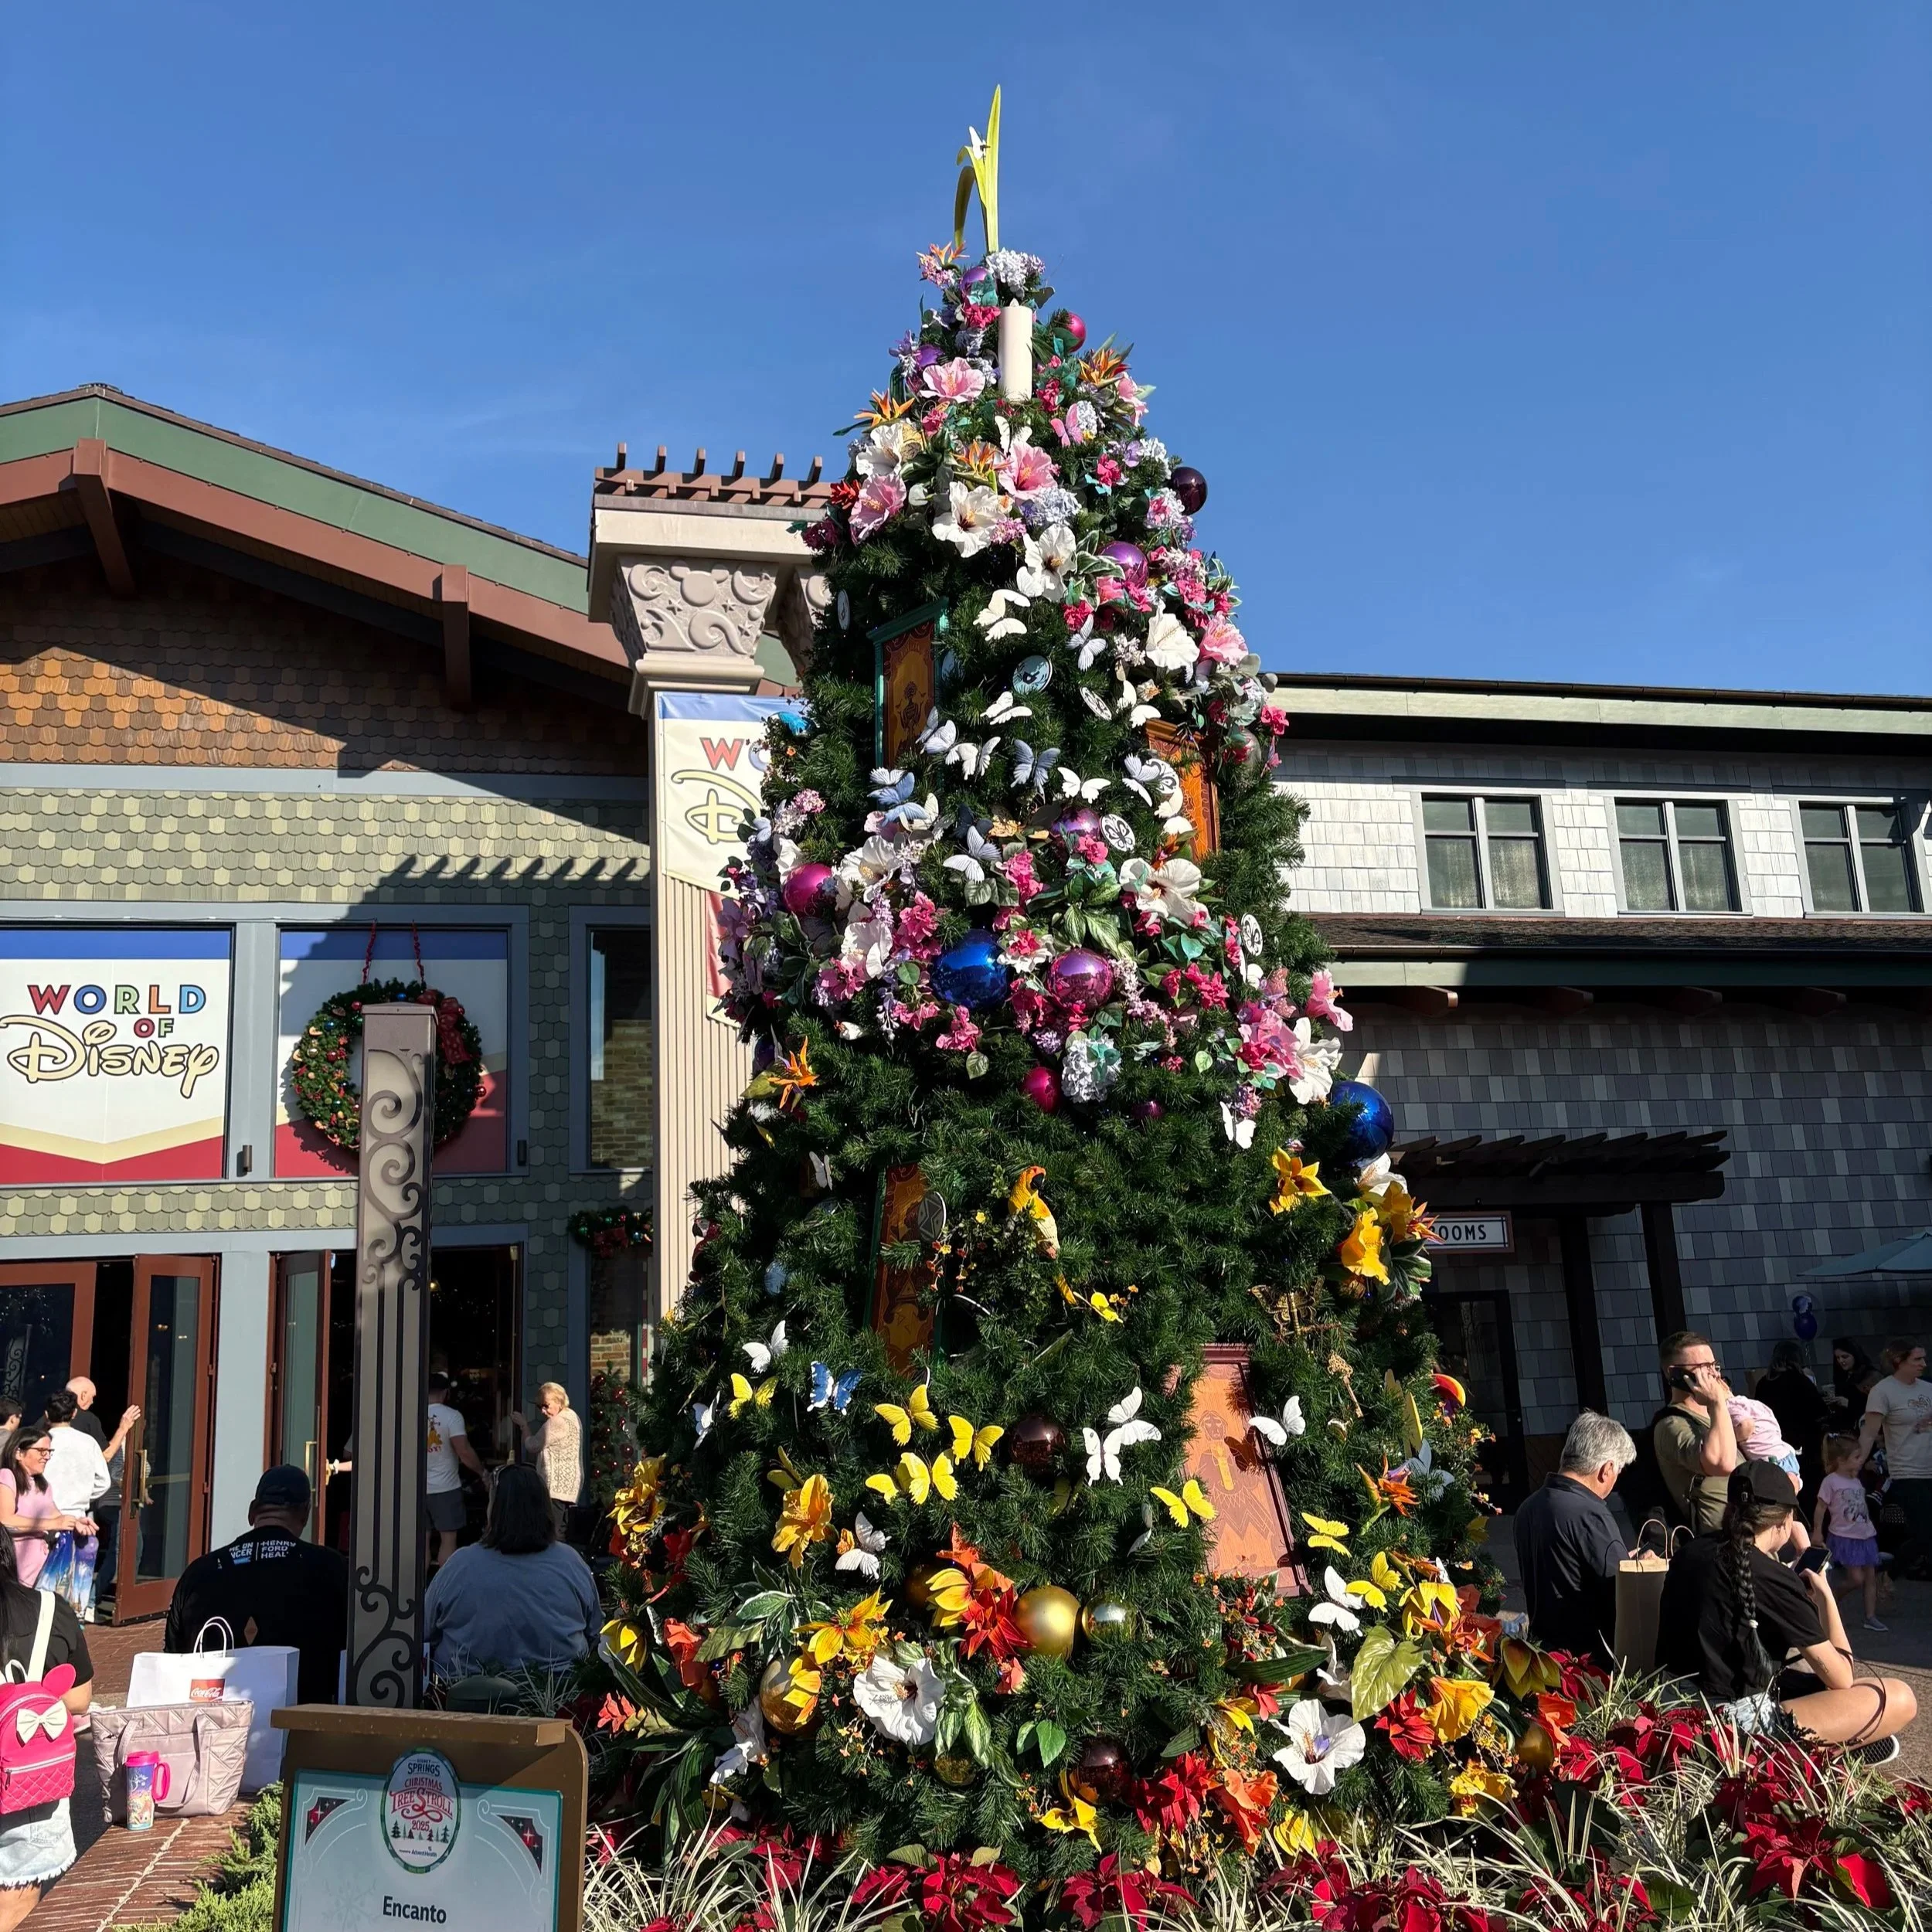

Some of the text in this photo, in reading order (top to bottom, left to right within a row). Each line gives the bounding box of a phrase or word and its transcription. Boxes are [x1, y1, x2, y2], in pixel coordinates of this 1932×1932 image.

[27, 984, 206, 1015] WORLD
[134, 1018, 175, 1038] OF
[407, 1763, 440, 1777] SPRINGS
[404, 1777, 443, 1791] CHRISTMAS
[389, 1787, 453, 1817] TREE STROLL
[412, 1820, 430, 1832] 2025
[383, 1895, 447, 1924] Encanto
